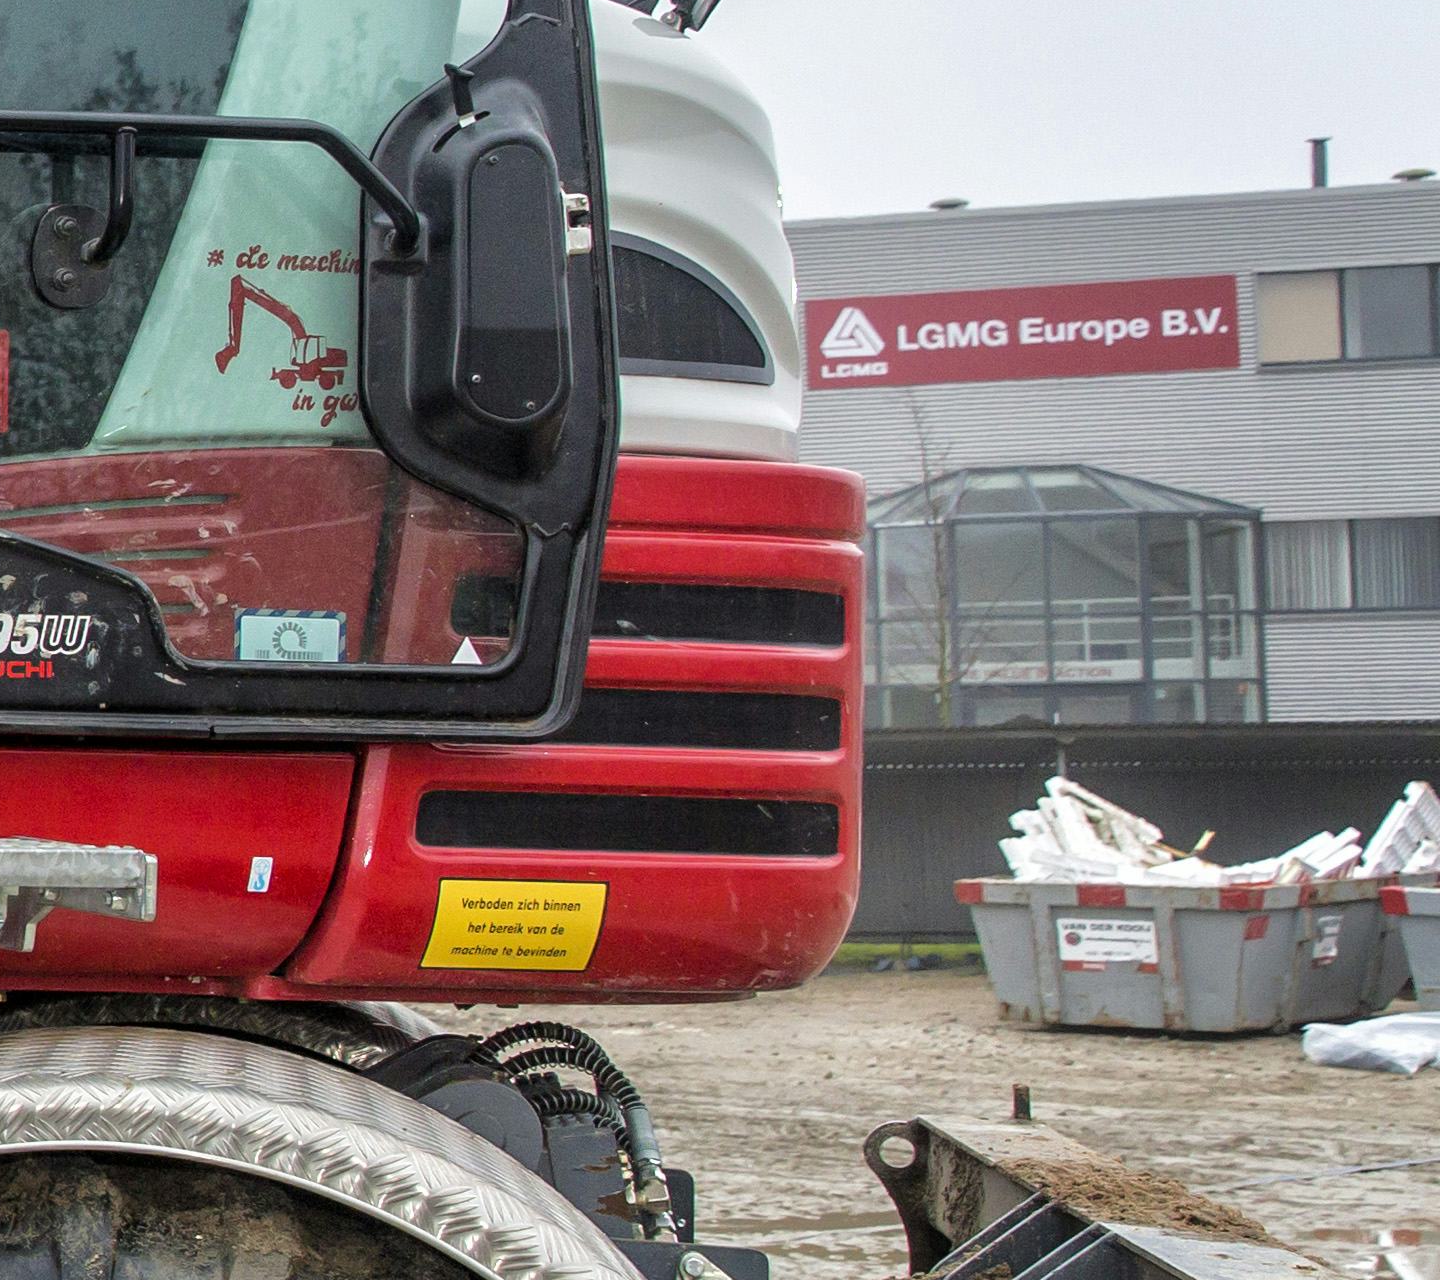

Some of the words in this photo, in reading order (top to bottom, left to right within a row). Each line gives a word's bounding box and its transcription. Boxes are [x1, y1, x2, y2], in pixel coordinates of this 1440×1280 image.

[236, 245, 270, 269] de
[277, 249, 360, 273] machin
[897, 320, 1009, 351] LGMG
[1019, 317, 1149, 346] Europe
[1162, 307, 1228, 336] B.V.
[821, 362, 888, 378] LGMG
[292, 388, 315, 411] in
[321, 392, 360, 428] gw
[461, 897, 513, 910] Verboden
[517, 898, 540, 910] zich
[543, 899, 581, 911] binnen
[467, 922, 486, 933] het
[489, 922, 524, 934] bereik
[527, 926, 547, 935] van
[550, 923, 565, 935] de
[451, 945, 498, 956] machine
[502, 946, 513, 956] te
[517, 946, 567, 957] bevinden
